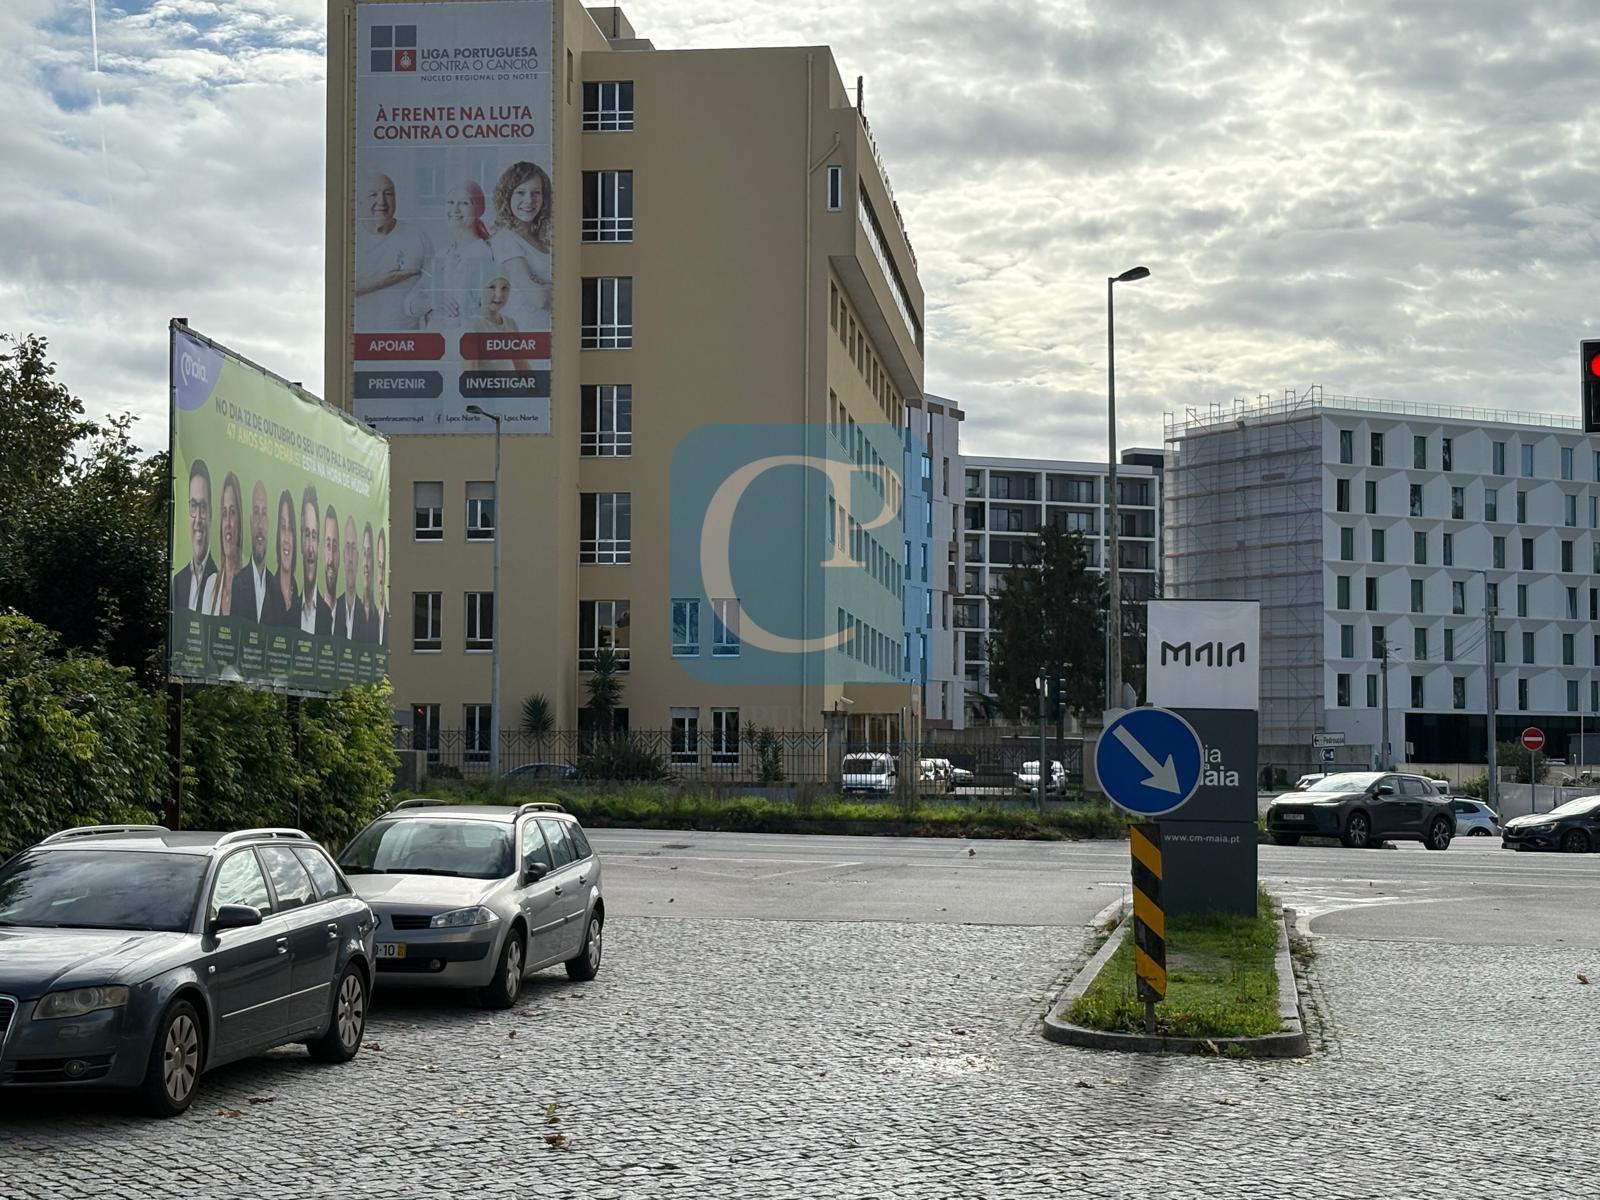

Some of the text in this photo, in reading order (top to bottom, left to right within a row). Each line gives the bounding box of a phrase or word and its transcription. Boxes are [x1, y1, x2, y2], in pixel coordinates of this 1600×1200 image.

[421, 46, 538, 60] LIGA PORTUGUESA
[421, 58, 538, 72] CONTRA O CANCRO
[455, 74, 495, 82] REGIONAL
[497, 73, 510, 81] DO
[513, 72, 538, 80] NORTE
[375, 104, 533, 122] À FRENTE NA LUTA
[373, 123, 535, 140] CONTRA O CANCRO
[369, 340, 415, 352] APOIAR
[486, 339, 536, 351] EDUCAR
[368, 378, 426, 390] PREVENIR
[466, 377, 536, 389] INVESTIGAR
[215, 397, 228, 416] NO
[229, 403, 243, 424] DIA
[244, 409, 252, 427] 12
[253, 413, 262, 431] DE
[263, 420, 296, 446] OUTUBRO
[1204, 744, 1221, 763] ia
[1163, 832, 1240, 844] www.cm-maia.pt
